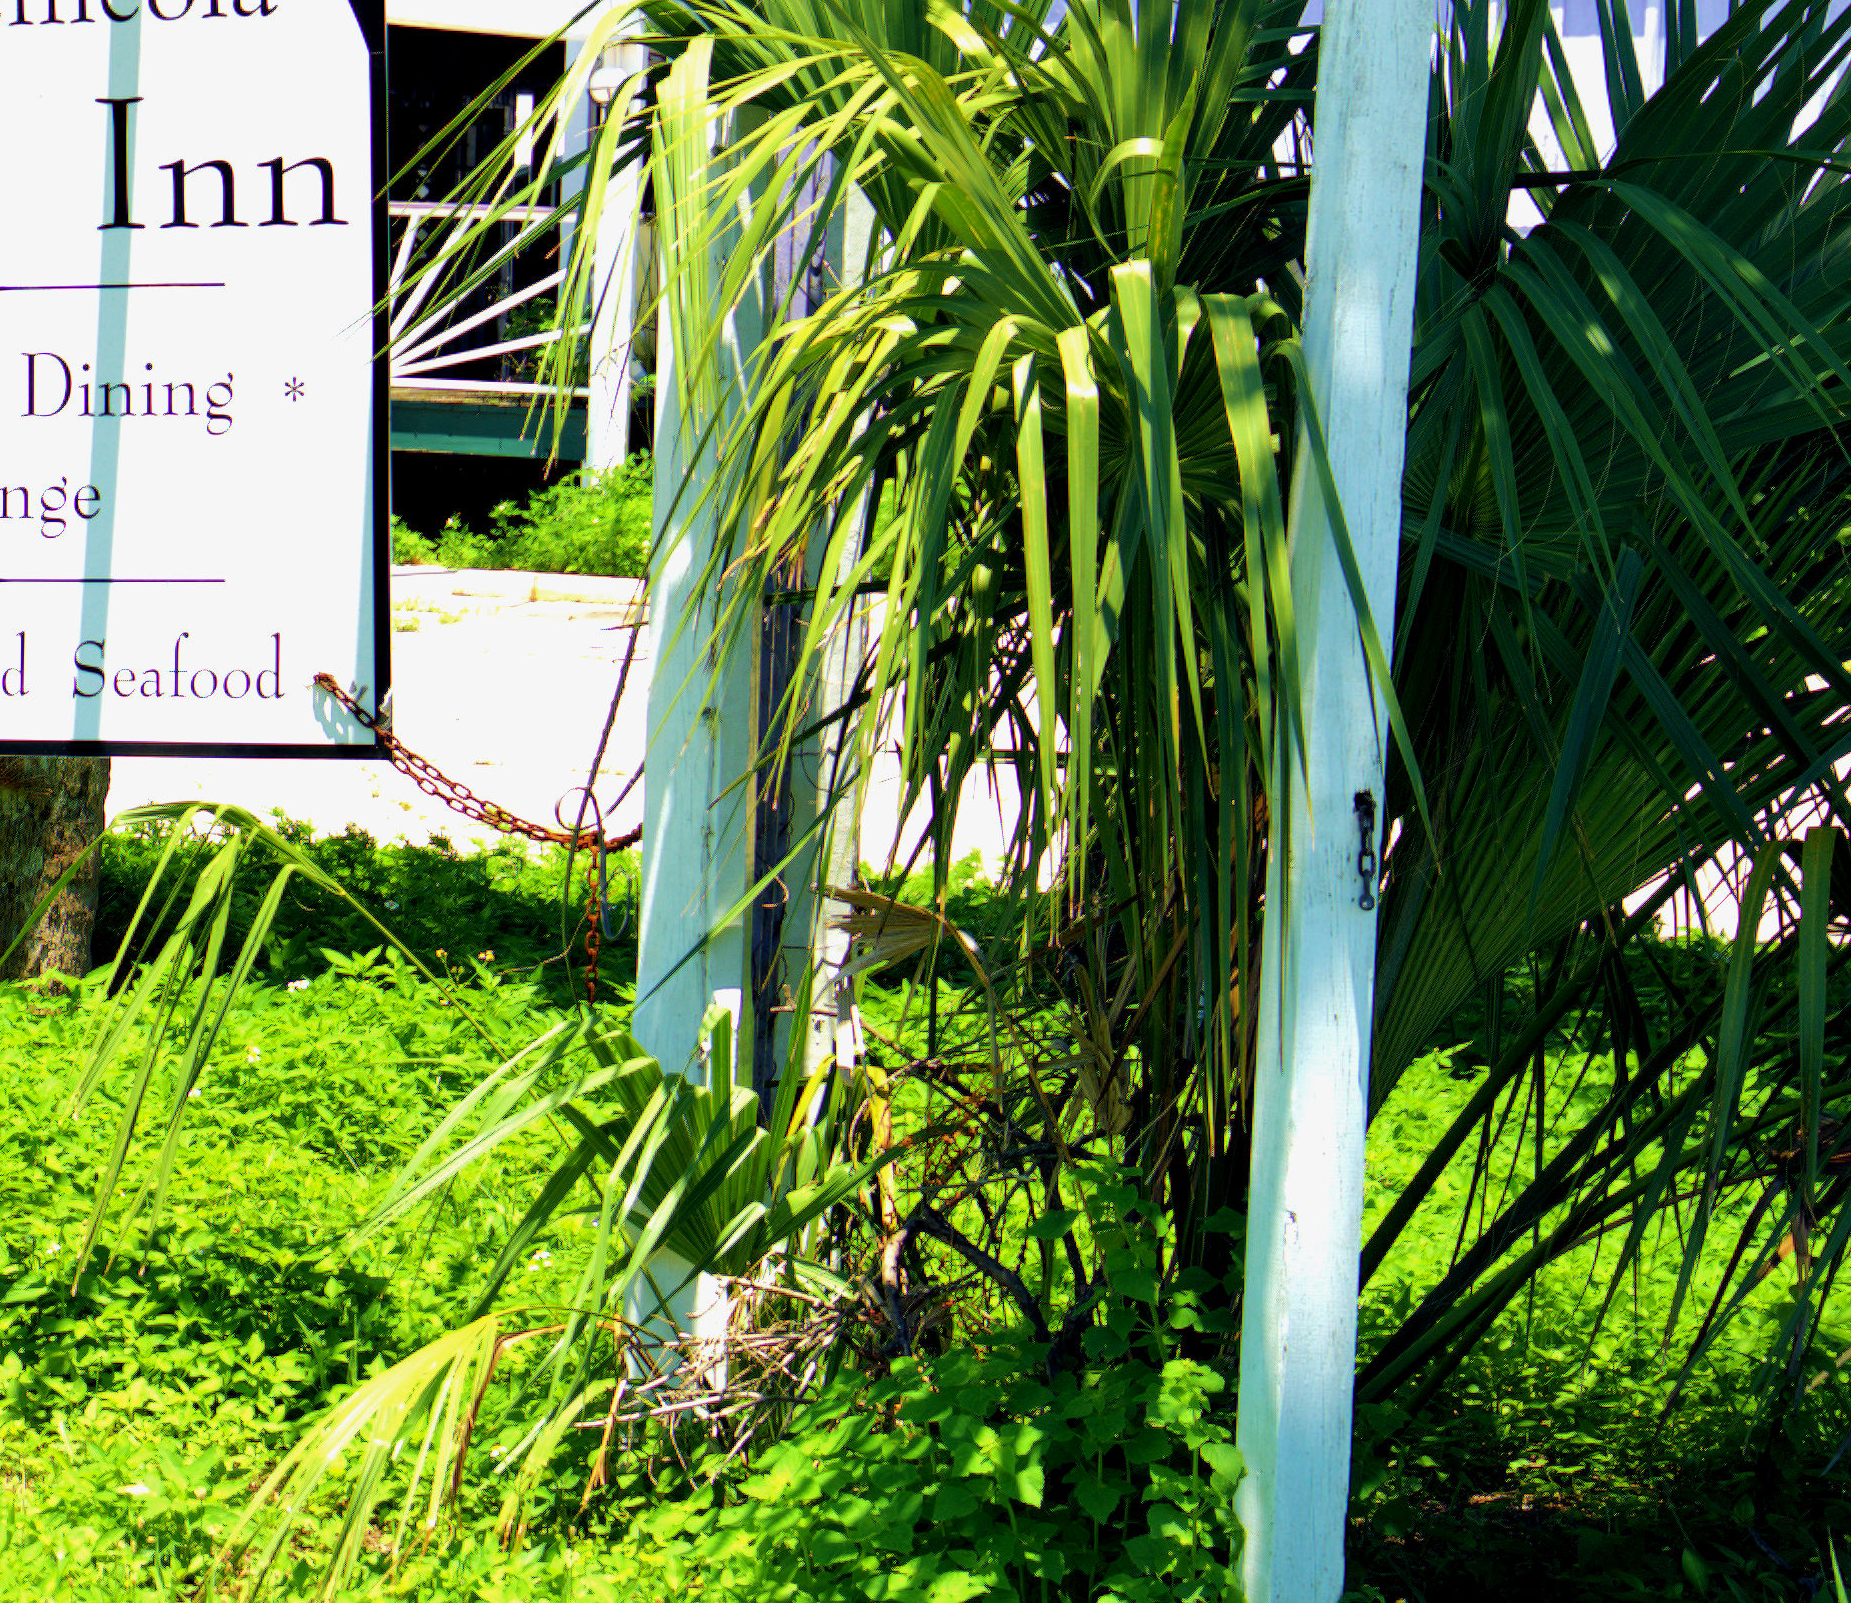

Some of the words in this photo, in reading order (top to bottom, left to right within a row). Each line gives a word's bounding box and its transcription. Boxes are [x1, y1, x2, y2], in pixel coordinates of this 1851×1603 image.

[95, 96, 349, 231] Inn
[21, 352, 234, 435] Dining
[72, 633, 285, 700] Seafood
